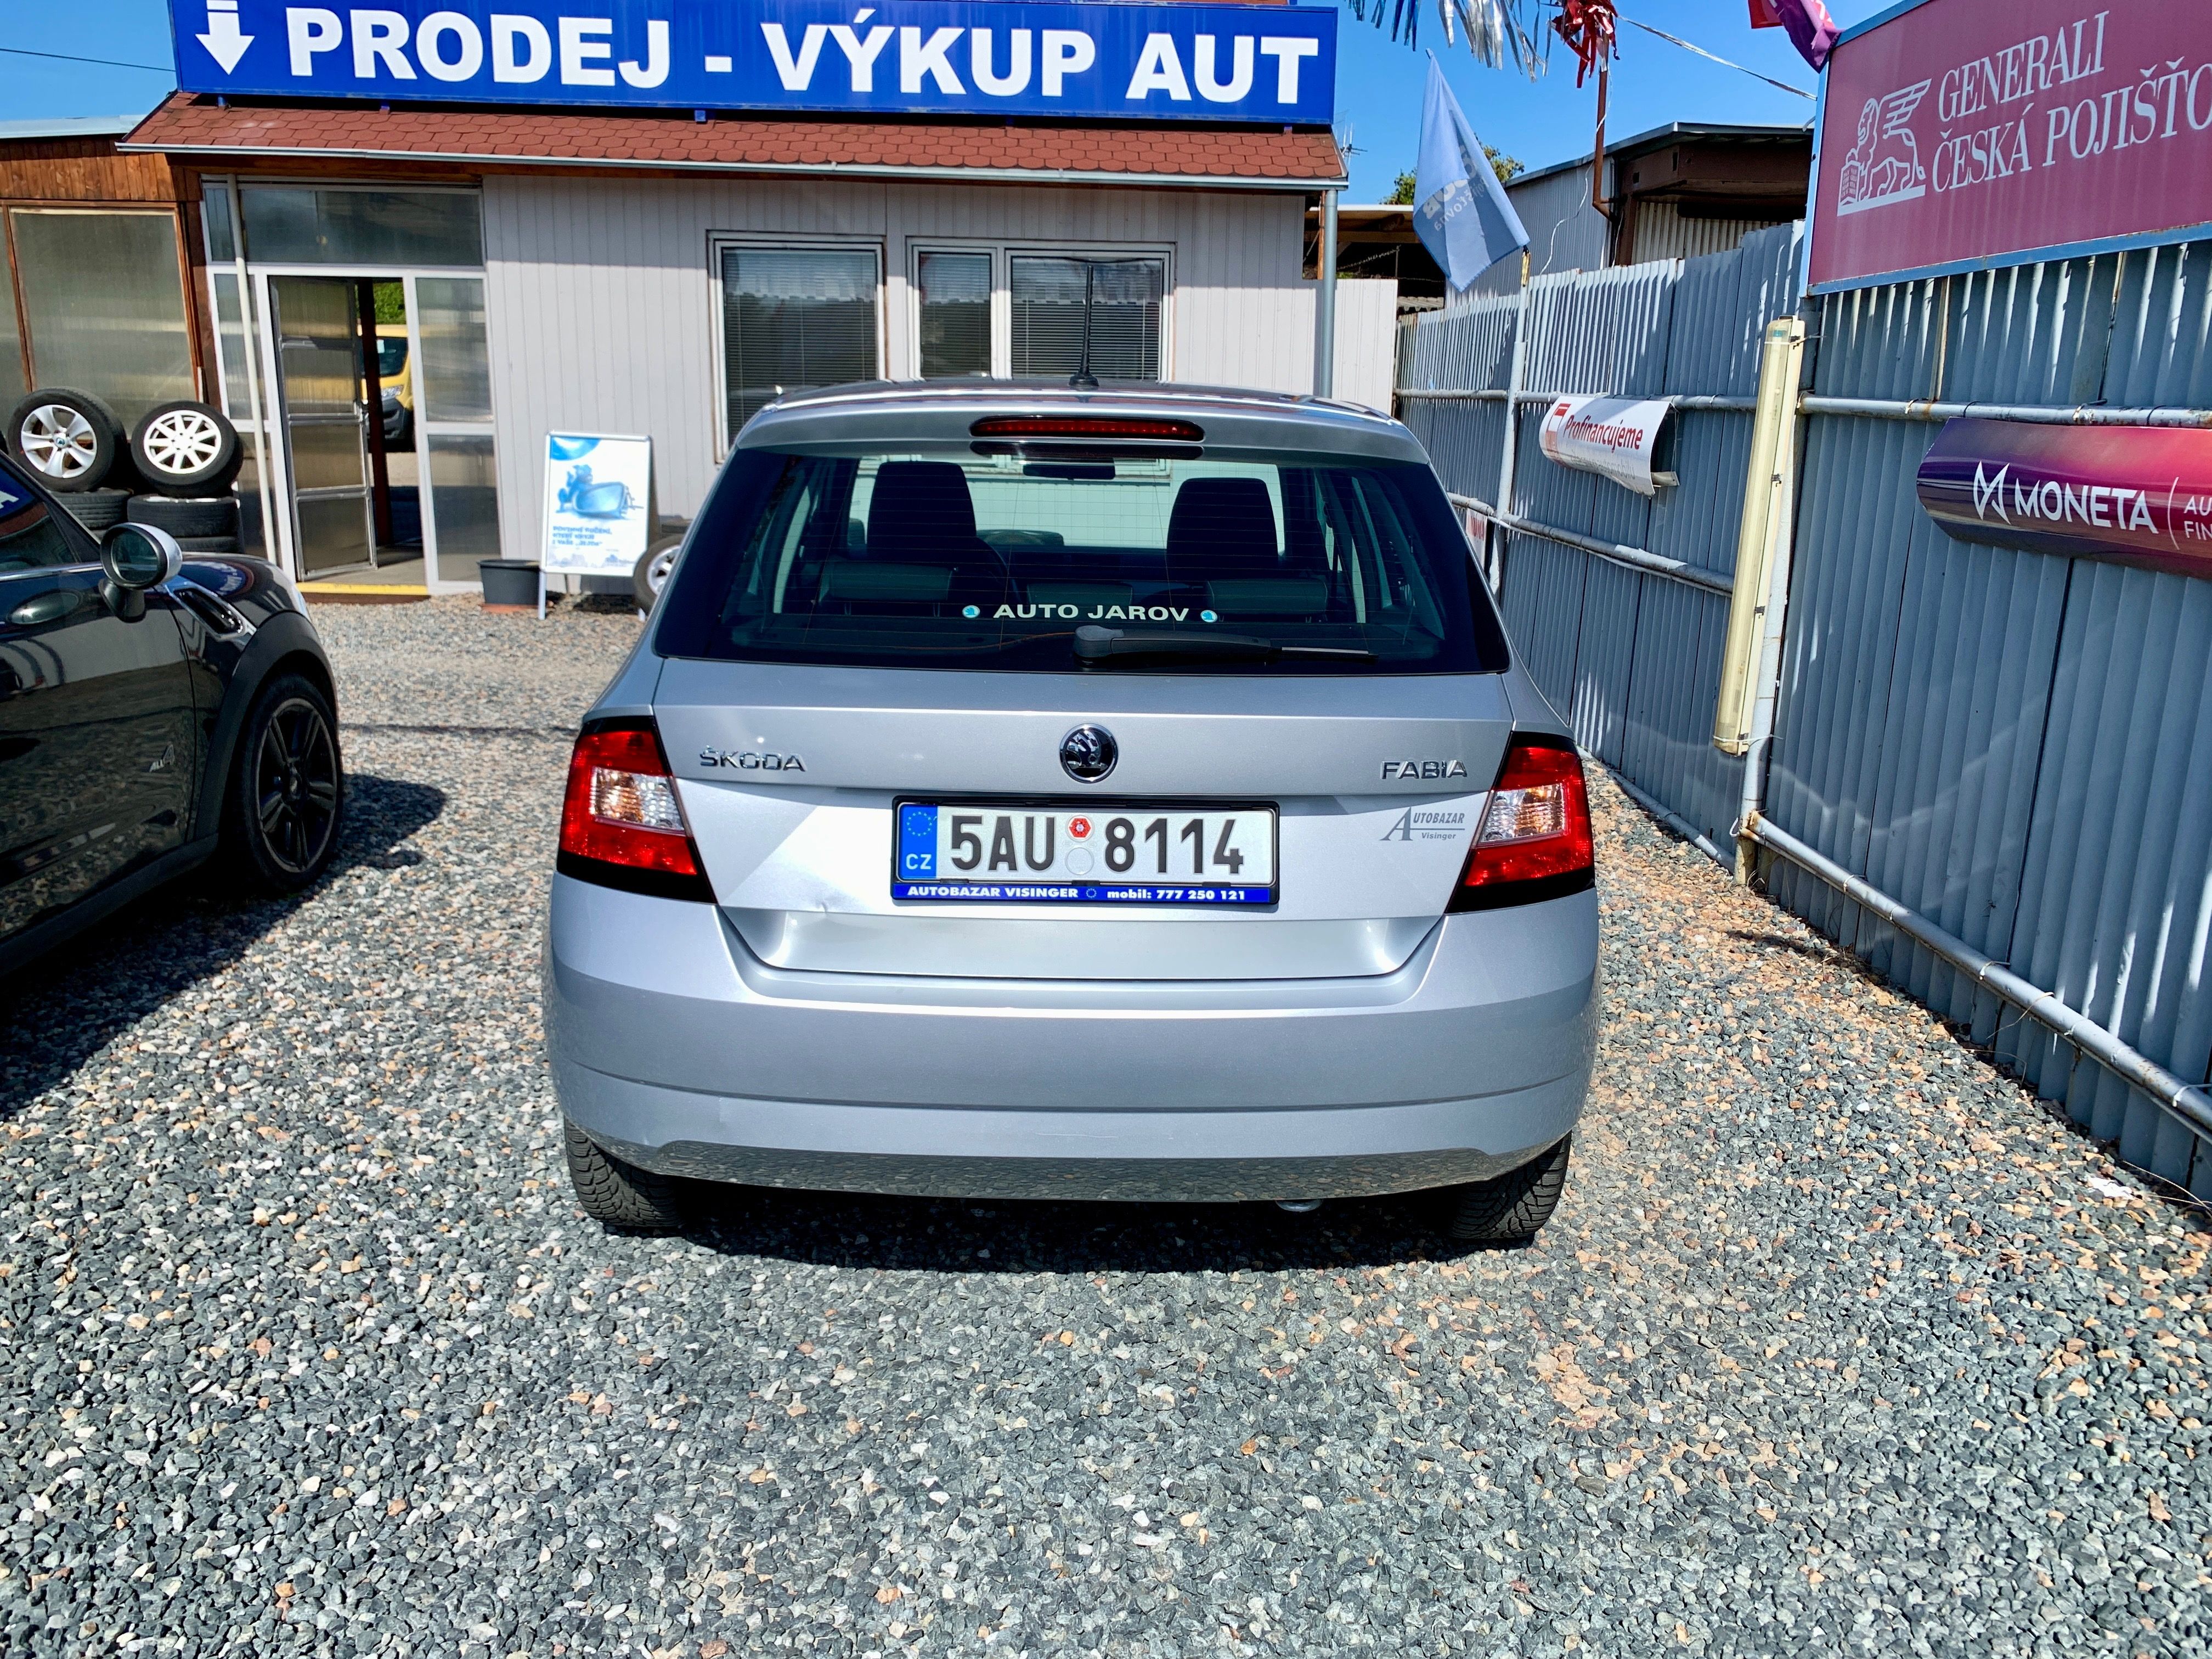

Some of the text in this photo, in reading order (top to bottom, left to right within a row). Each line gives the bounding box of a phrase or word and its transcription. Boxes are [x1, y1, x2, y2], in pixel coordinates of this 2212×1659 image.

[286, 7, 670, 89] PRODEJ
[760, 8, 1096, 98] VÝKUP
[1125, 33, 1319, 104] AUT
[1939, 10, 2109, 122] GENERALI
[1932, 103, 2035, 193] ČESKÁ
[1563, 414, 1644, 454] Profinancujeme
[2015, 478, 2159, 534] MONETA
[992, 603, 1190, 622] AUTO JAROV
[699, 744, 808, 772] ŠKODA
[1380, 759, 1468, 780] FABIA
[1379, 806, 1465, 840] AUTOBAZAR
[1421, 832, 1457, 841] Visinger
[951, 815, 1245, 874] 5AU 8114
[906, 854, 932, 871] CZ
[907, 885, 1246, 900] AUTOBAZAR VISINGER mobil: 777 250 121
